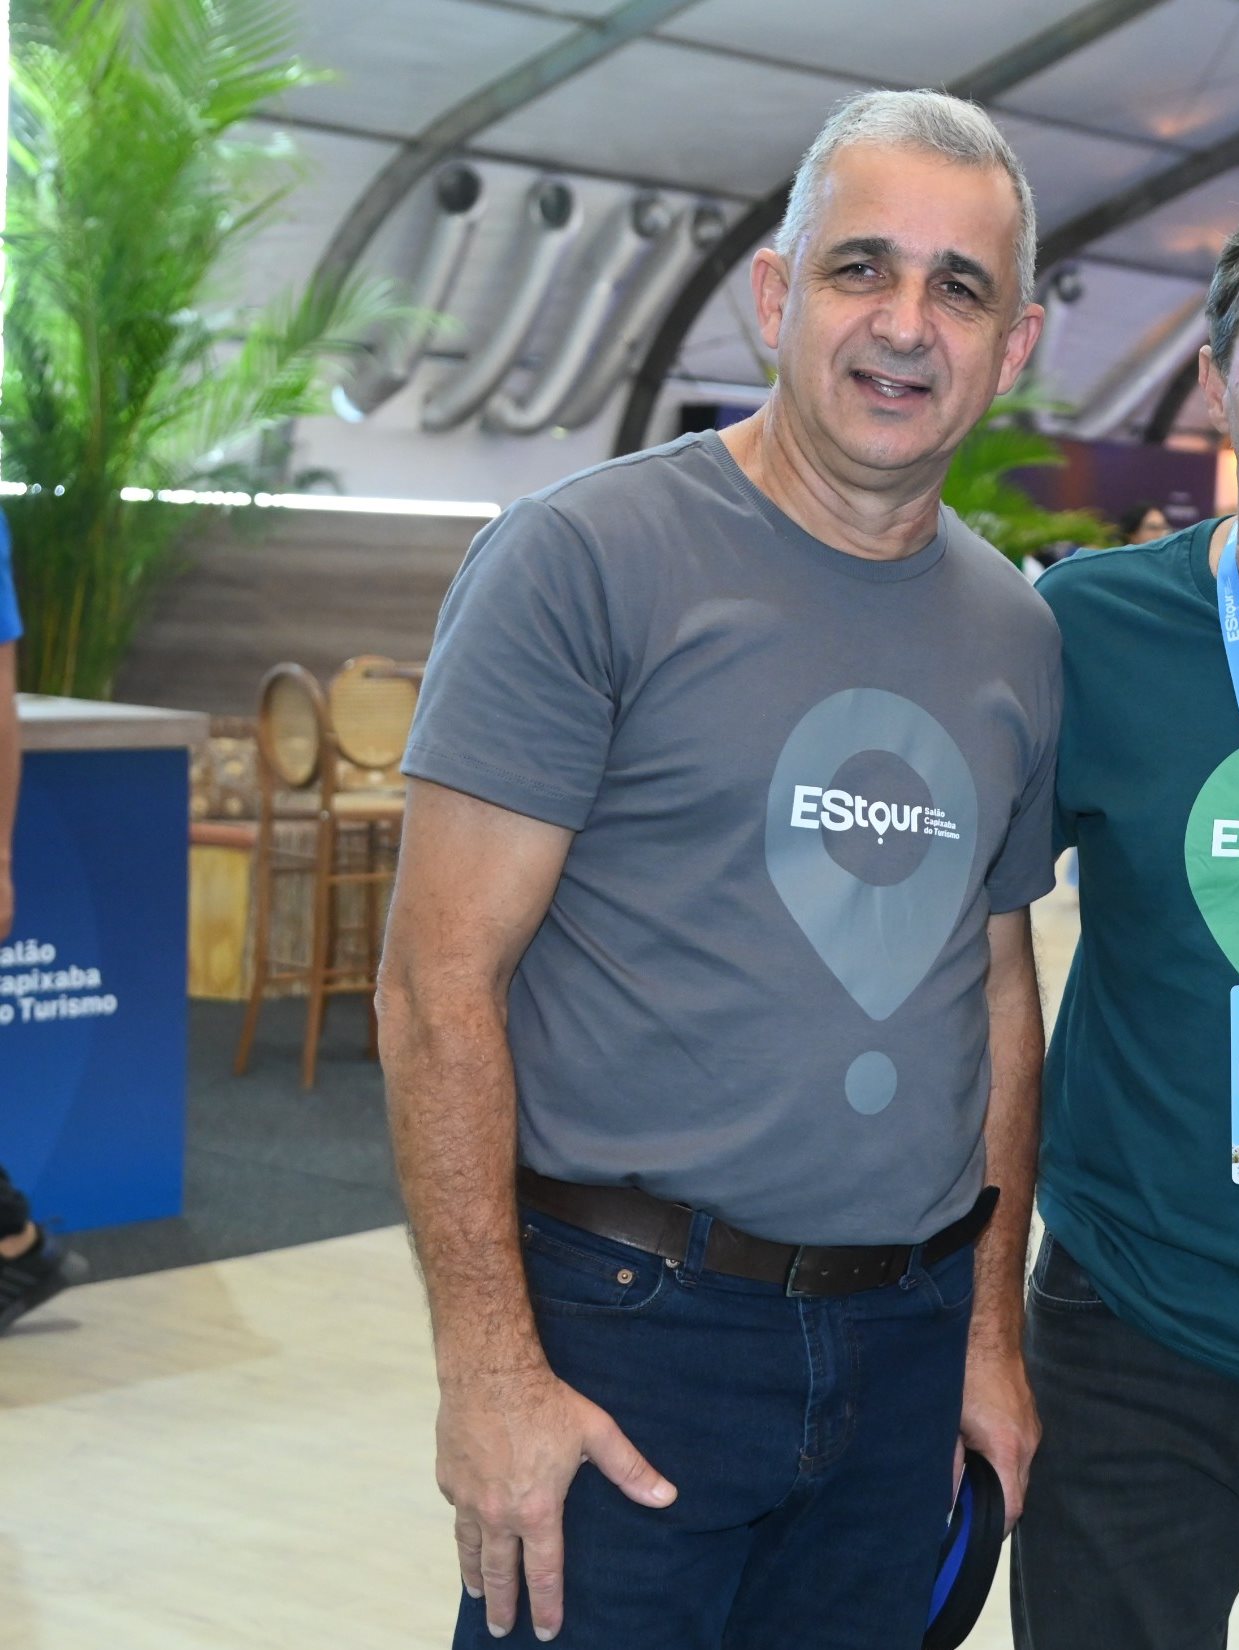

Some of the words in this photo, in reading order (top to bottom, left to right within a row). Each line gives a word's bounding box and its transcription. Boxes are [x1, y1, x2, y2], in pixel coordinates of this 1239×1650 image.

[790, 784, 922, 841] EStour
[924, 807, 946, 818] Salão
[924, 817, 956, 830] Capixaba
[923, 827, 933, 835] do
[934, 828, 960, 840] Turismo
[0, 939, 56, 966] alão
[0, 964, 102, 996] apixaba
[0, 1003, 15, 1026] o
[18, 994, 118, 1023] Turismo
